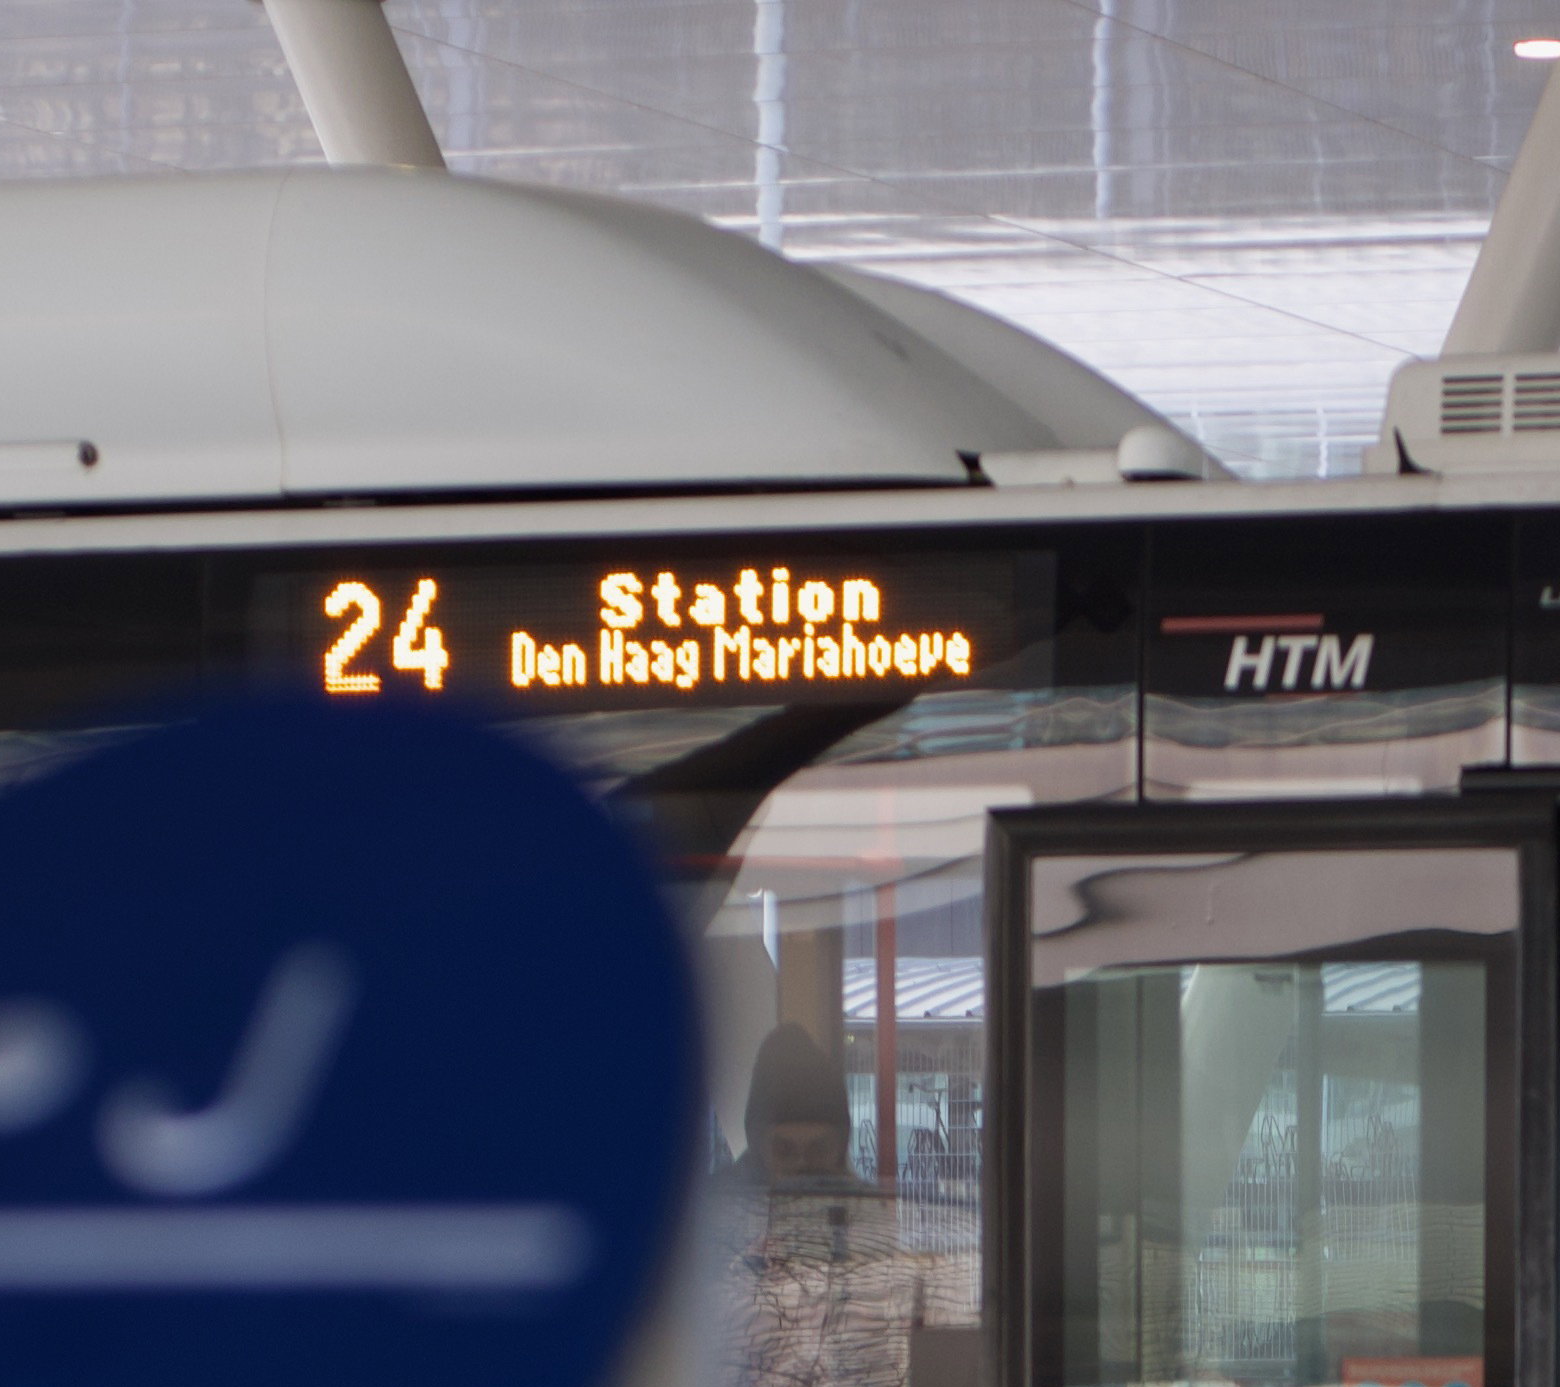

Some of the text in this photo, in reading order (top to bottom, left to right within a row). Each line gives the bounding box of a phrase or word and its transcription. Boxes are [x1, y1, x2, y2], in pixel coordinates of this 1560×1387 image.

[599, 567, 881, 628] Station
[324, 579, 449, 693] 24
[511, 622, 972, 688] Den Haag Mariahoeve
[1223, 633, 1375, 691] HTM
[92, 942, 357, 1197] J
